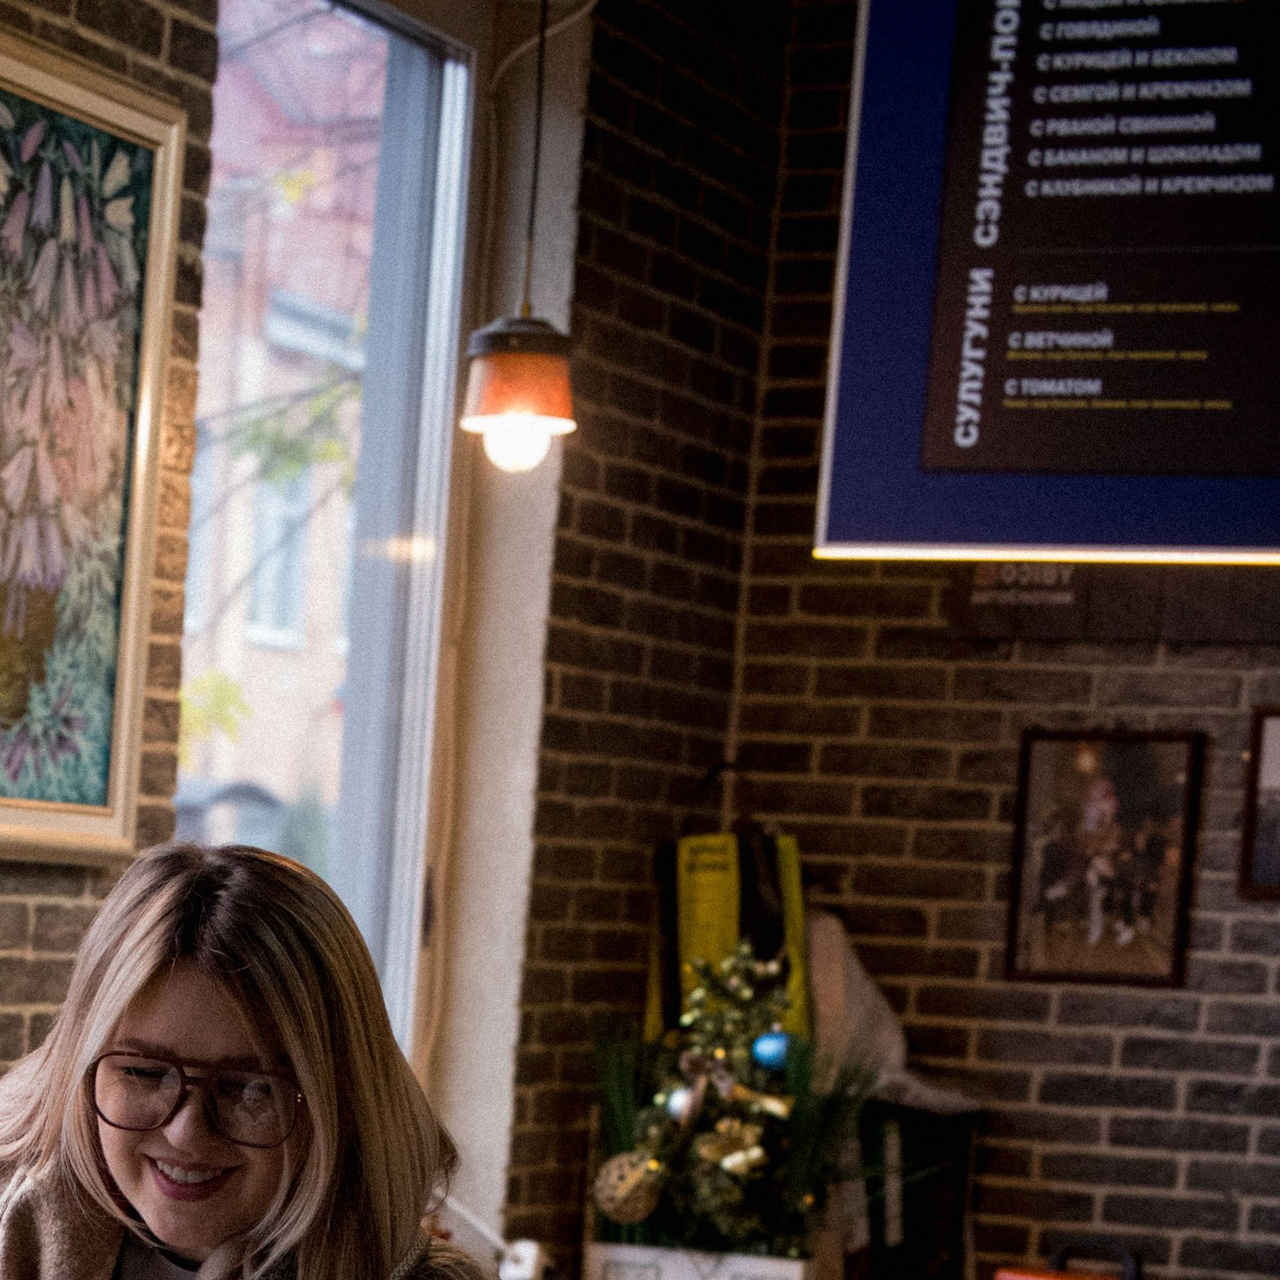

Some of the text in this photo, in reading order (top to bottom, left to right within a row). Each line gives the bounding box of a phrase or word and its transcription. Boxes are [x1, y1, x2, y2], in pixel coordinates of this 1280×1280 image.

[1039, 22, 1054, 41] С
[1036, 46, 1237, 71] С КУРИЦЕЙ И БЕКОНОМ
[1033, 85, 1047, 103] С
[1122, 83, 1136, 101] И
[1030, 119, 1043, 137] С
[1028, 143, 1261, 167] С БАНАНОМ И ШОКОЛАДОМ
[1025, 179, 1038, 197] С
[1145, 177, 1159, 194] И
[1014, 281, 1108, 302] С КУРИЦЕЙ
[1008, 328, 1113, 349] С ВЕТЧИНОЙ
[953, 268, 995, 448] СУЛУГУНИ
[1004, 378, 1102, 396] С ТОМАТОМ
